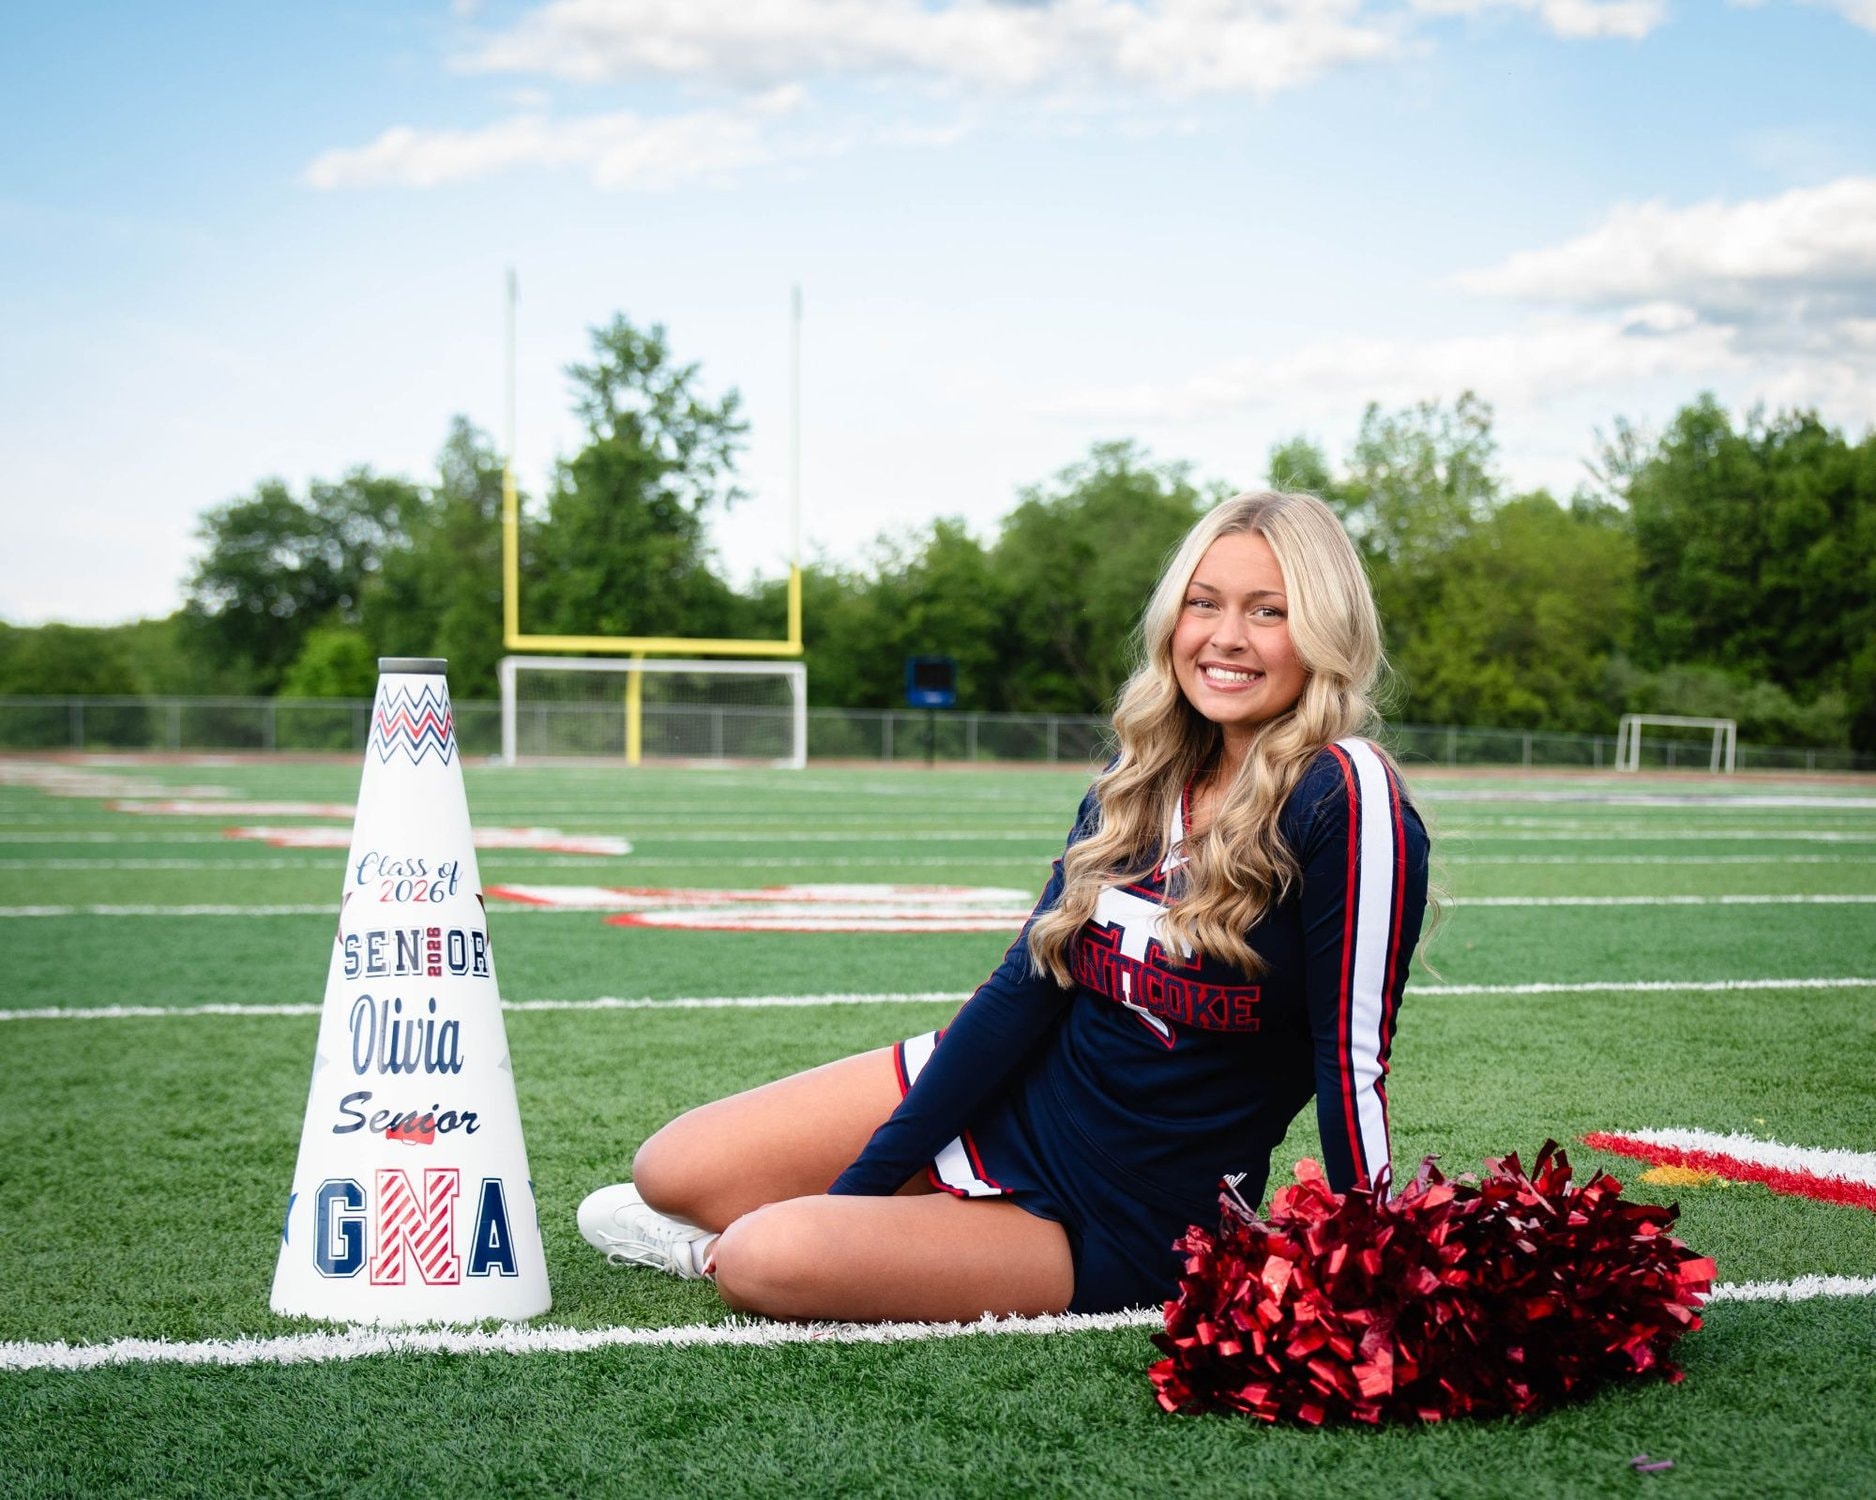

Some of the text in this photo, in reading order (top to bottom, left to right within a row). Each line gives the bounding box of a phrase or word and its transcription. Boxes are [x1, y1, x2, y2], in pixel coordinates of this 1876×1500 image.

[356, 852, 463, 896] Class of
[380, 879, 445, 903] 2026
[350, 994, 464, 1075] Olivia
[332, 1091, 480, 1134] Senior
